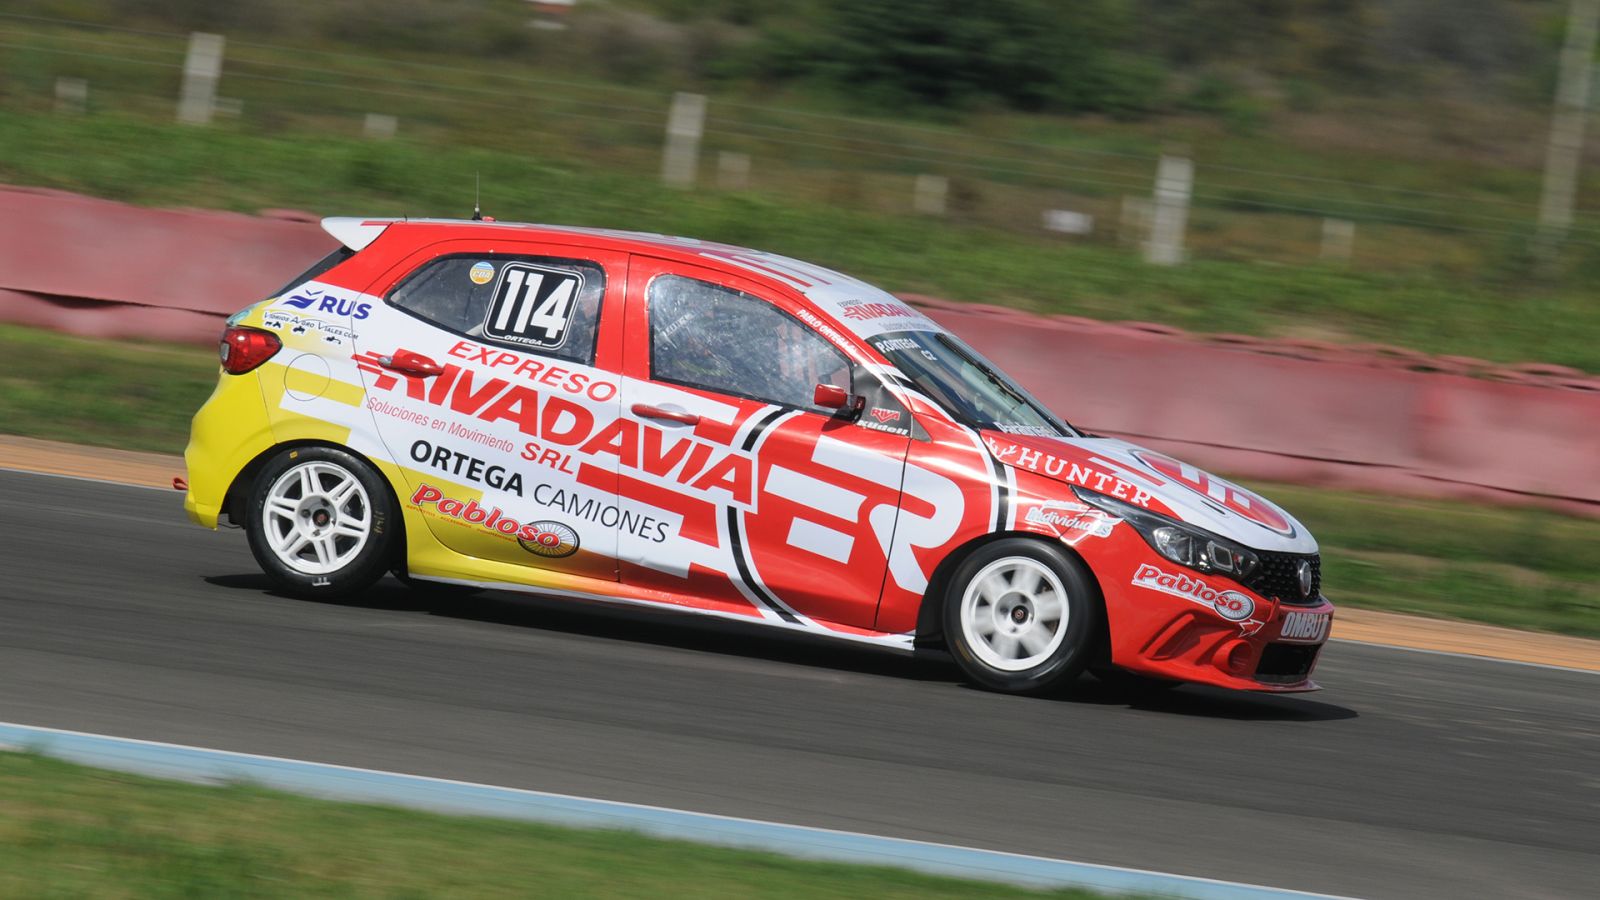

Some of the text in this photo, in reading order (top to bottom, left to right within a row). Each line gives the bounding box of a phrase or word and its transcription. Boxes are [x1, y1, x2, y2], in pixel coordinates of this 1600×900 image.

[318, 295, 373, 320] RUS
[494, 269, 576, 339] 114
[796, 309, 823, 328] PABLO
[503, 334, 544, 346] ORTEGA
[448, 340, 618, 402] EXPRESO
[352, 347, 753, 506] RIVADAVIA
[366, 396, 515, 454] Soluciones en Movimiento
[871, 408, 900, 423] RIVA
[520, 441, 575, 475] SRL
[1015, 447, 1152, 507] HUNTER
[410, 439, 670, 544] ORTEGA CAMIONES
[410, 482, 561, 549] Pabloso
[1137, 566, 1243, 612] Pabloso
